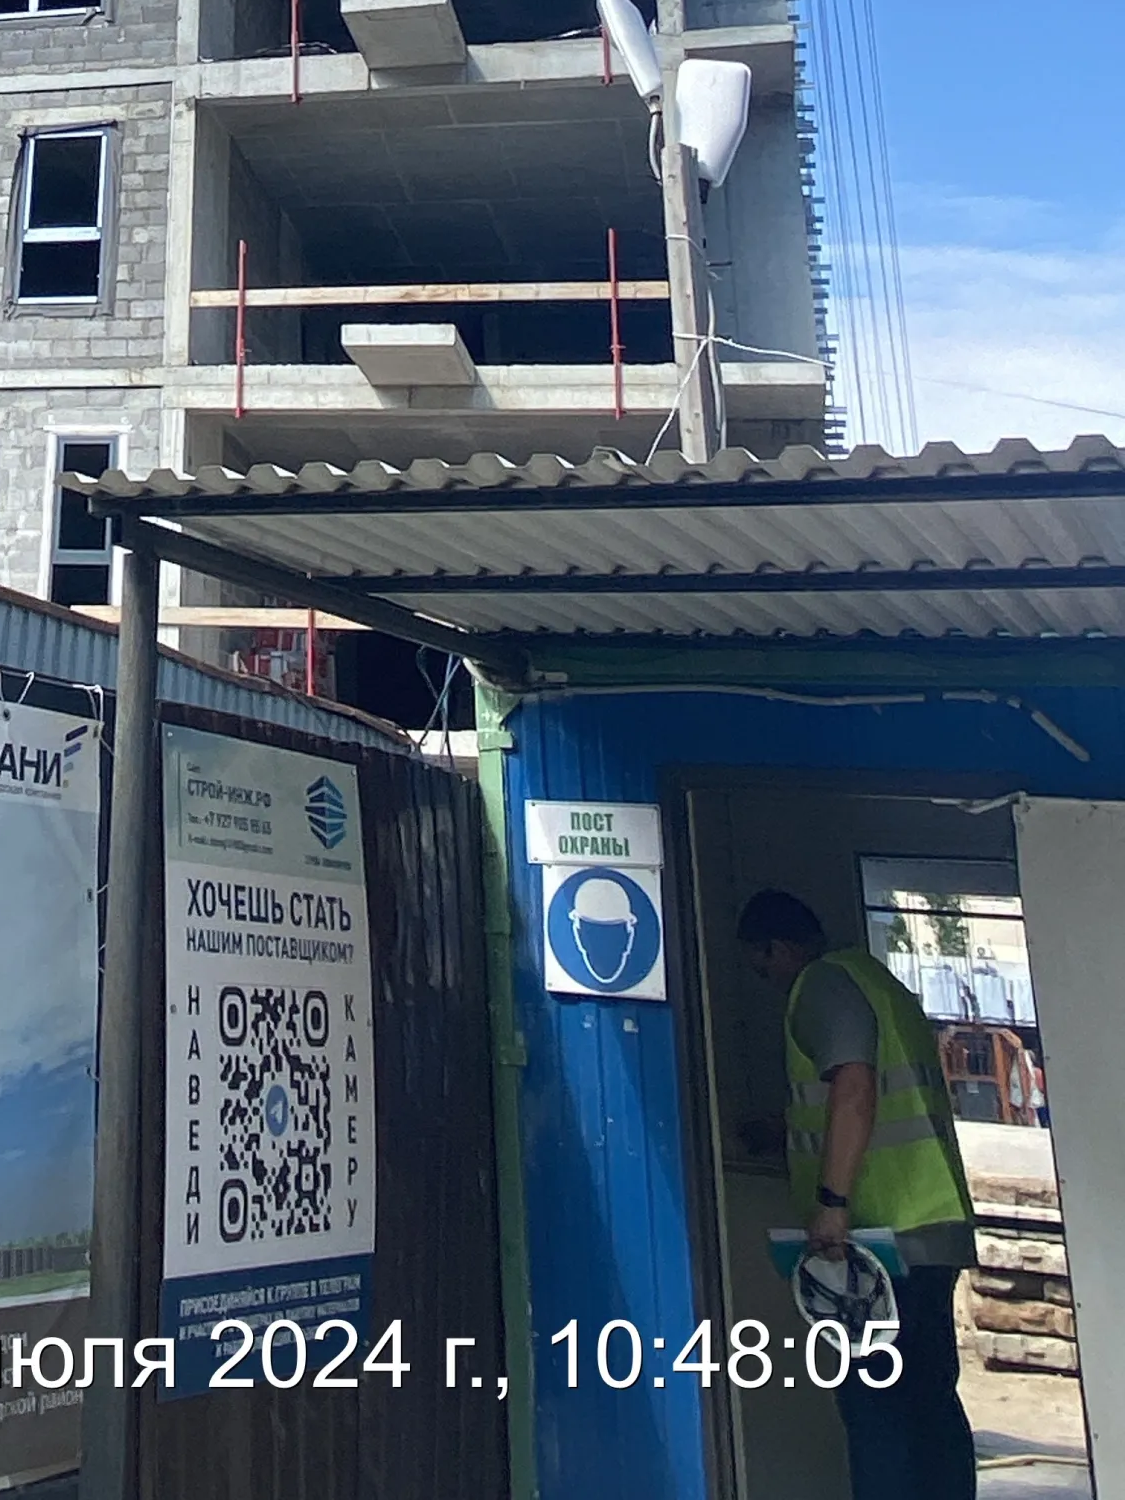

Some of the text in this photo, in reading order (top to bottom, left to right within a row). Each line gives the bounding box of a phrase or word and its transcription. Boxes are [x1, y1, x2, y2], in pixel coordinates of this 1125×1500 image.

[570, 812, 614, 832] ПОСТ
[558, 835, 630, 856] ОХРАНЫ
[187, 878, 352, 931] ХОЧЕШЬ СТАТЬ
[186, 927, 354, 965] НАШИМ ПОСТАВЩИКОМ?
[185, 984, 202, 1245] НАВЕДИ
[343, 993, 359, 1228] КАМЕРУ
